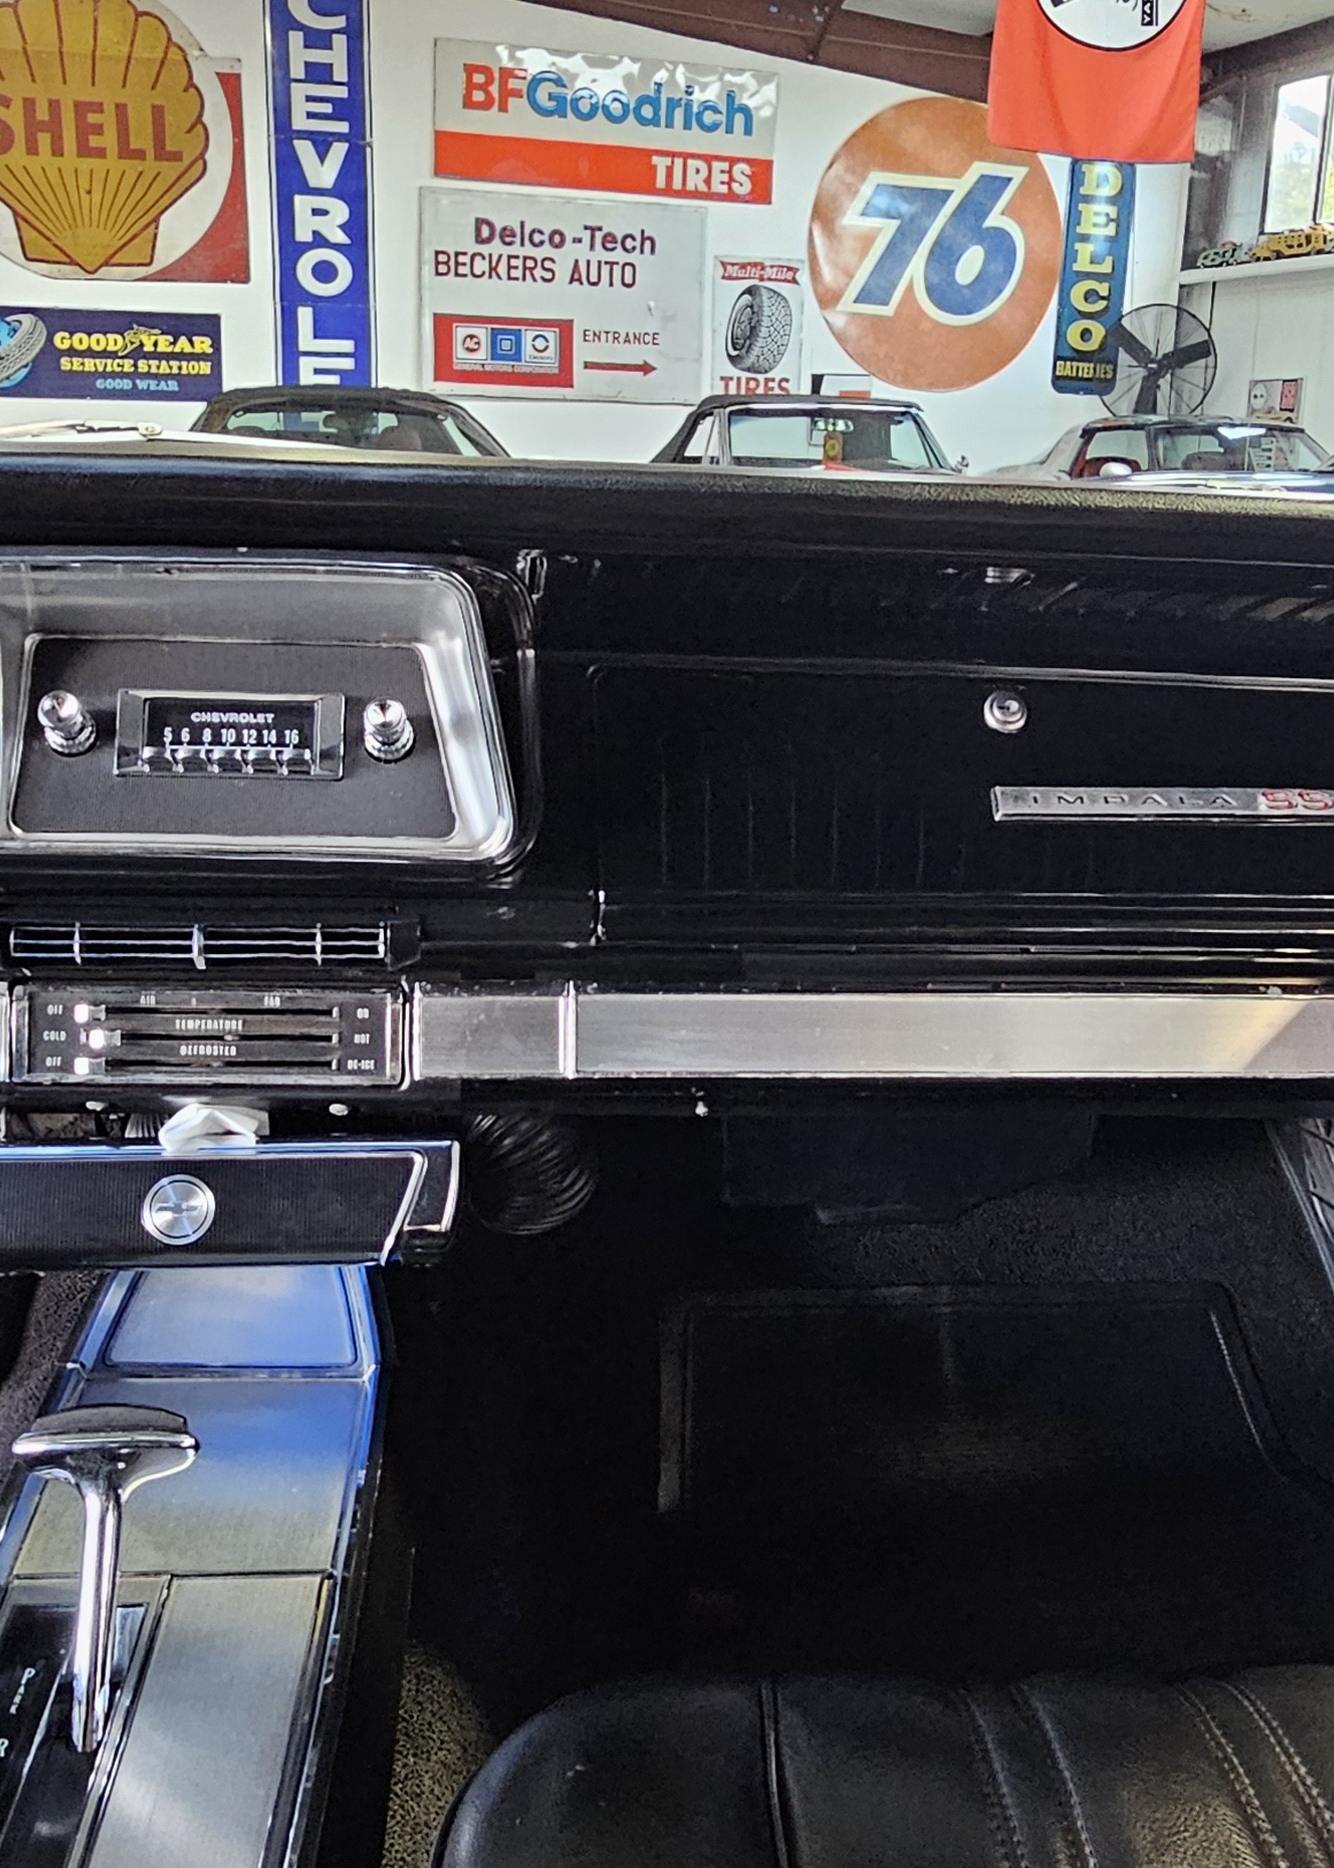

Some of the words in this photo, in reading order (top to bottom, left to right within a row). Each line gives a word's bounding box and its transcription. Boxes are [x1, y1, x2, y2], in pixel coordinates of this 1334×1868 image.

[462, 62, 755, 137] BFGoodrich
[652, 156, 752, 195] TIRES
[836, 161, 1029, 326] 76
[1068, 163, 1123, 353] DELCO
[434, 249, 556, 283] BECKERS
[568, 258, 637, 289] AUTO
[582, 329, 661, 346] ENTRANCE
[60, 356, 135, 373] SERVICE
[137, 359, 212, 375] STATION
[95, 378, 133, 391] GOOD
[136, 379, 179, 392] WEAR
[190, 711, 275, 724] CHEVROLET
[163, 727, 173, 742] 5
[181, 728, 190, 742] 6
[202, 728, 212, 743] 8
[221, 728, 236, 743] 10
[242, 729, 257, 744] 12
[263, 729, 277, 744] 14
[285, 730, 299, 744] 16
[1260, 788, 1334, 811] SS
[175, 1019, 243, 1031] TEMPERATURE
[43, 1031, 66, 1042] COLD
[354, 1034, 370, 1045] HOT
[347, 1059, 375, 1071] DE-ICE
